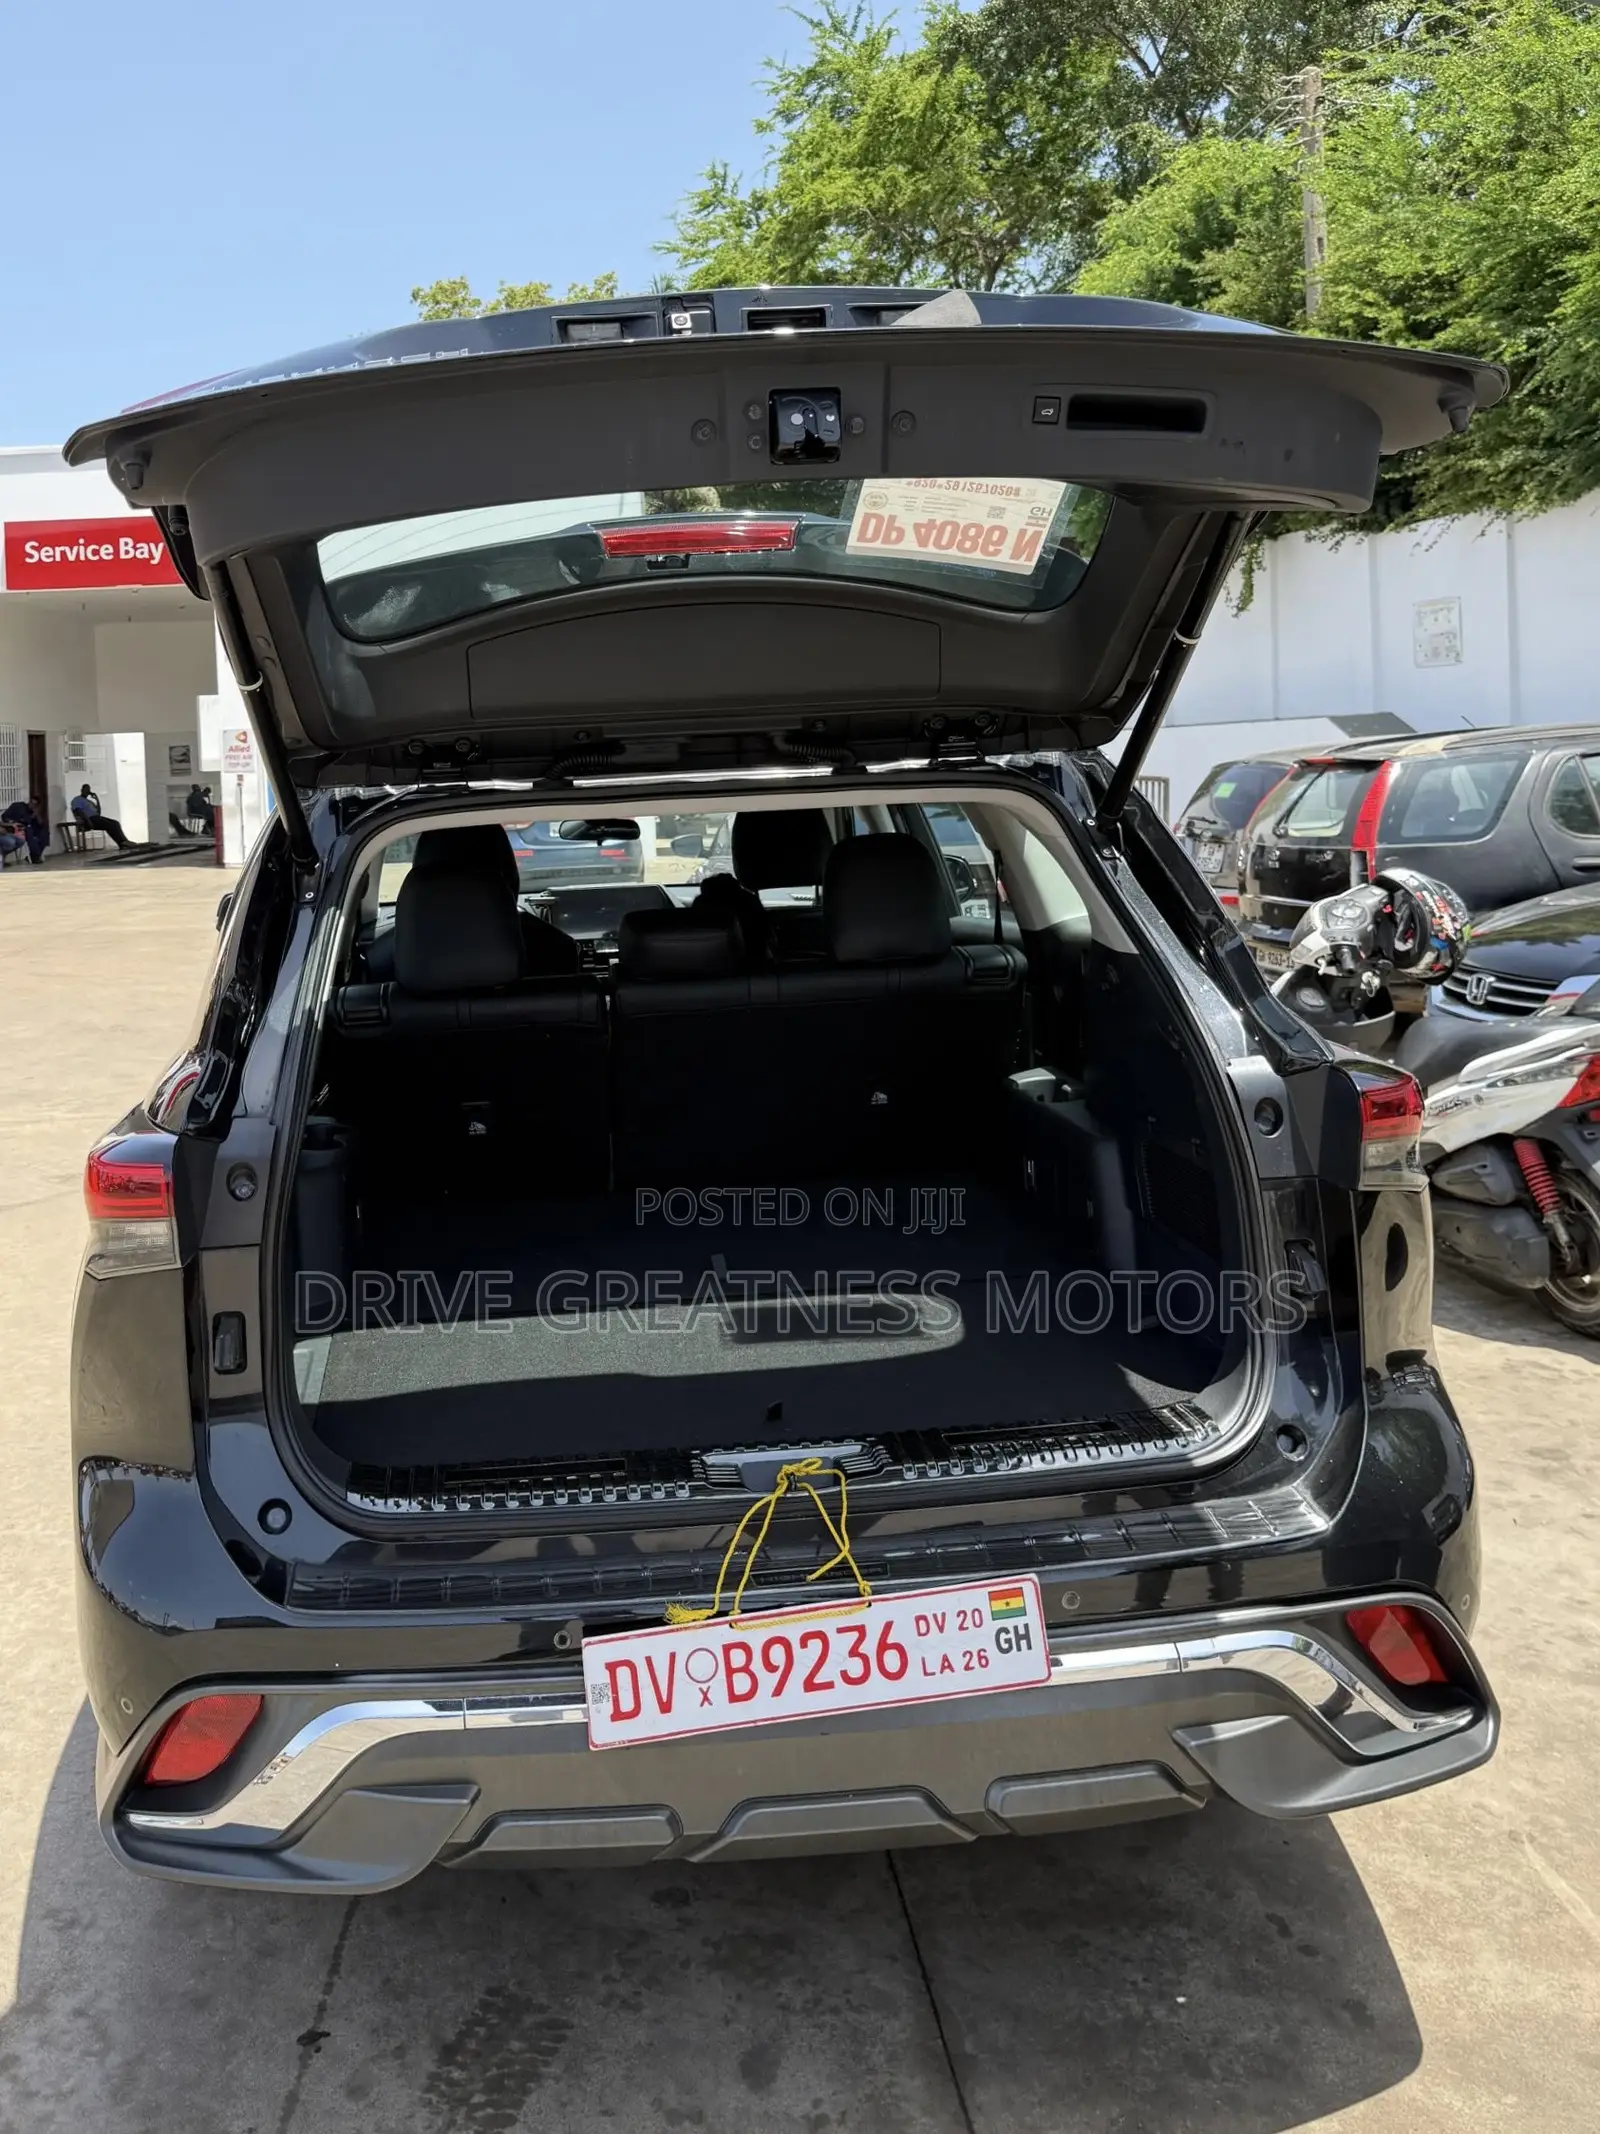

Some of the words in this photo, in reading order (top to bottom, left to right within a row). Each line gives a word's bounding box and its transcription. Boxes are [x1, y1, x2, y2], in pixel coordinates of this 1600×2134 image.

[24, 538, 114, 564] Service
[118, 537, 164, 565] Bay
[228, 745, 251, 753] Allied
[914, 1612, 946, 1637] DV
[956, 1608, 984, 1631] 20
[994, 1622, 1033, 1654] GH
[604, 1651, 676, 1722] DV
[721, 1620, 909, 1704] B9236
[920, 1653, 955, 1677] LA
[962, 1648, 990, 1671] 26
